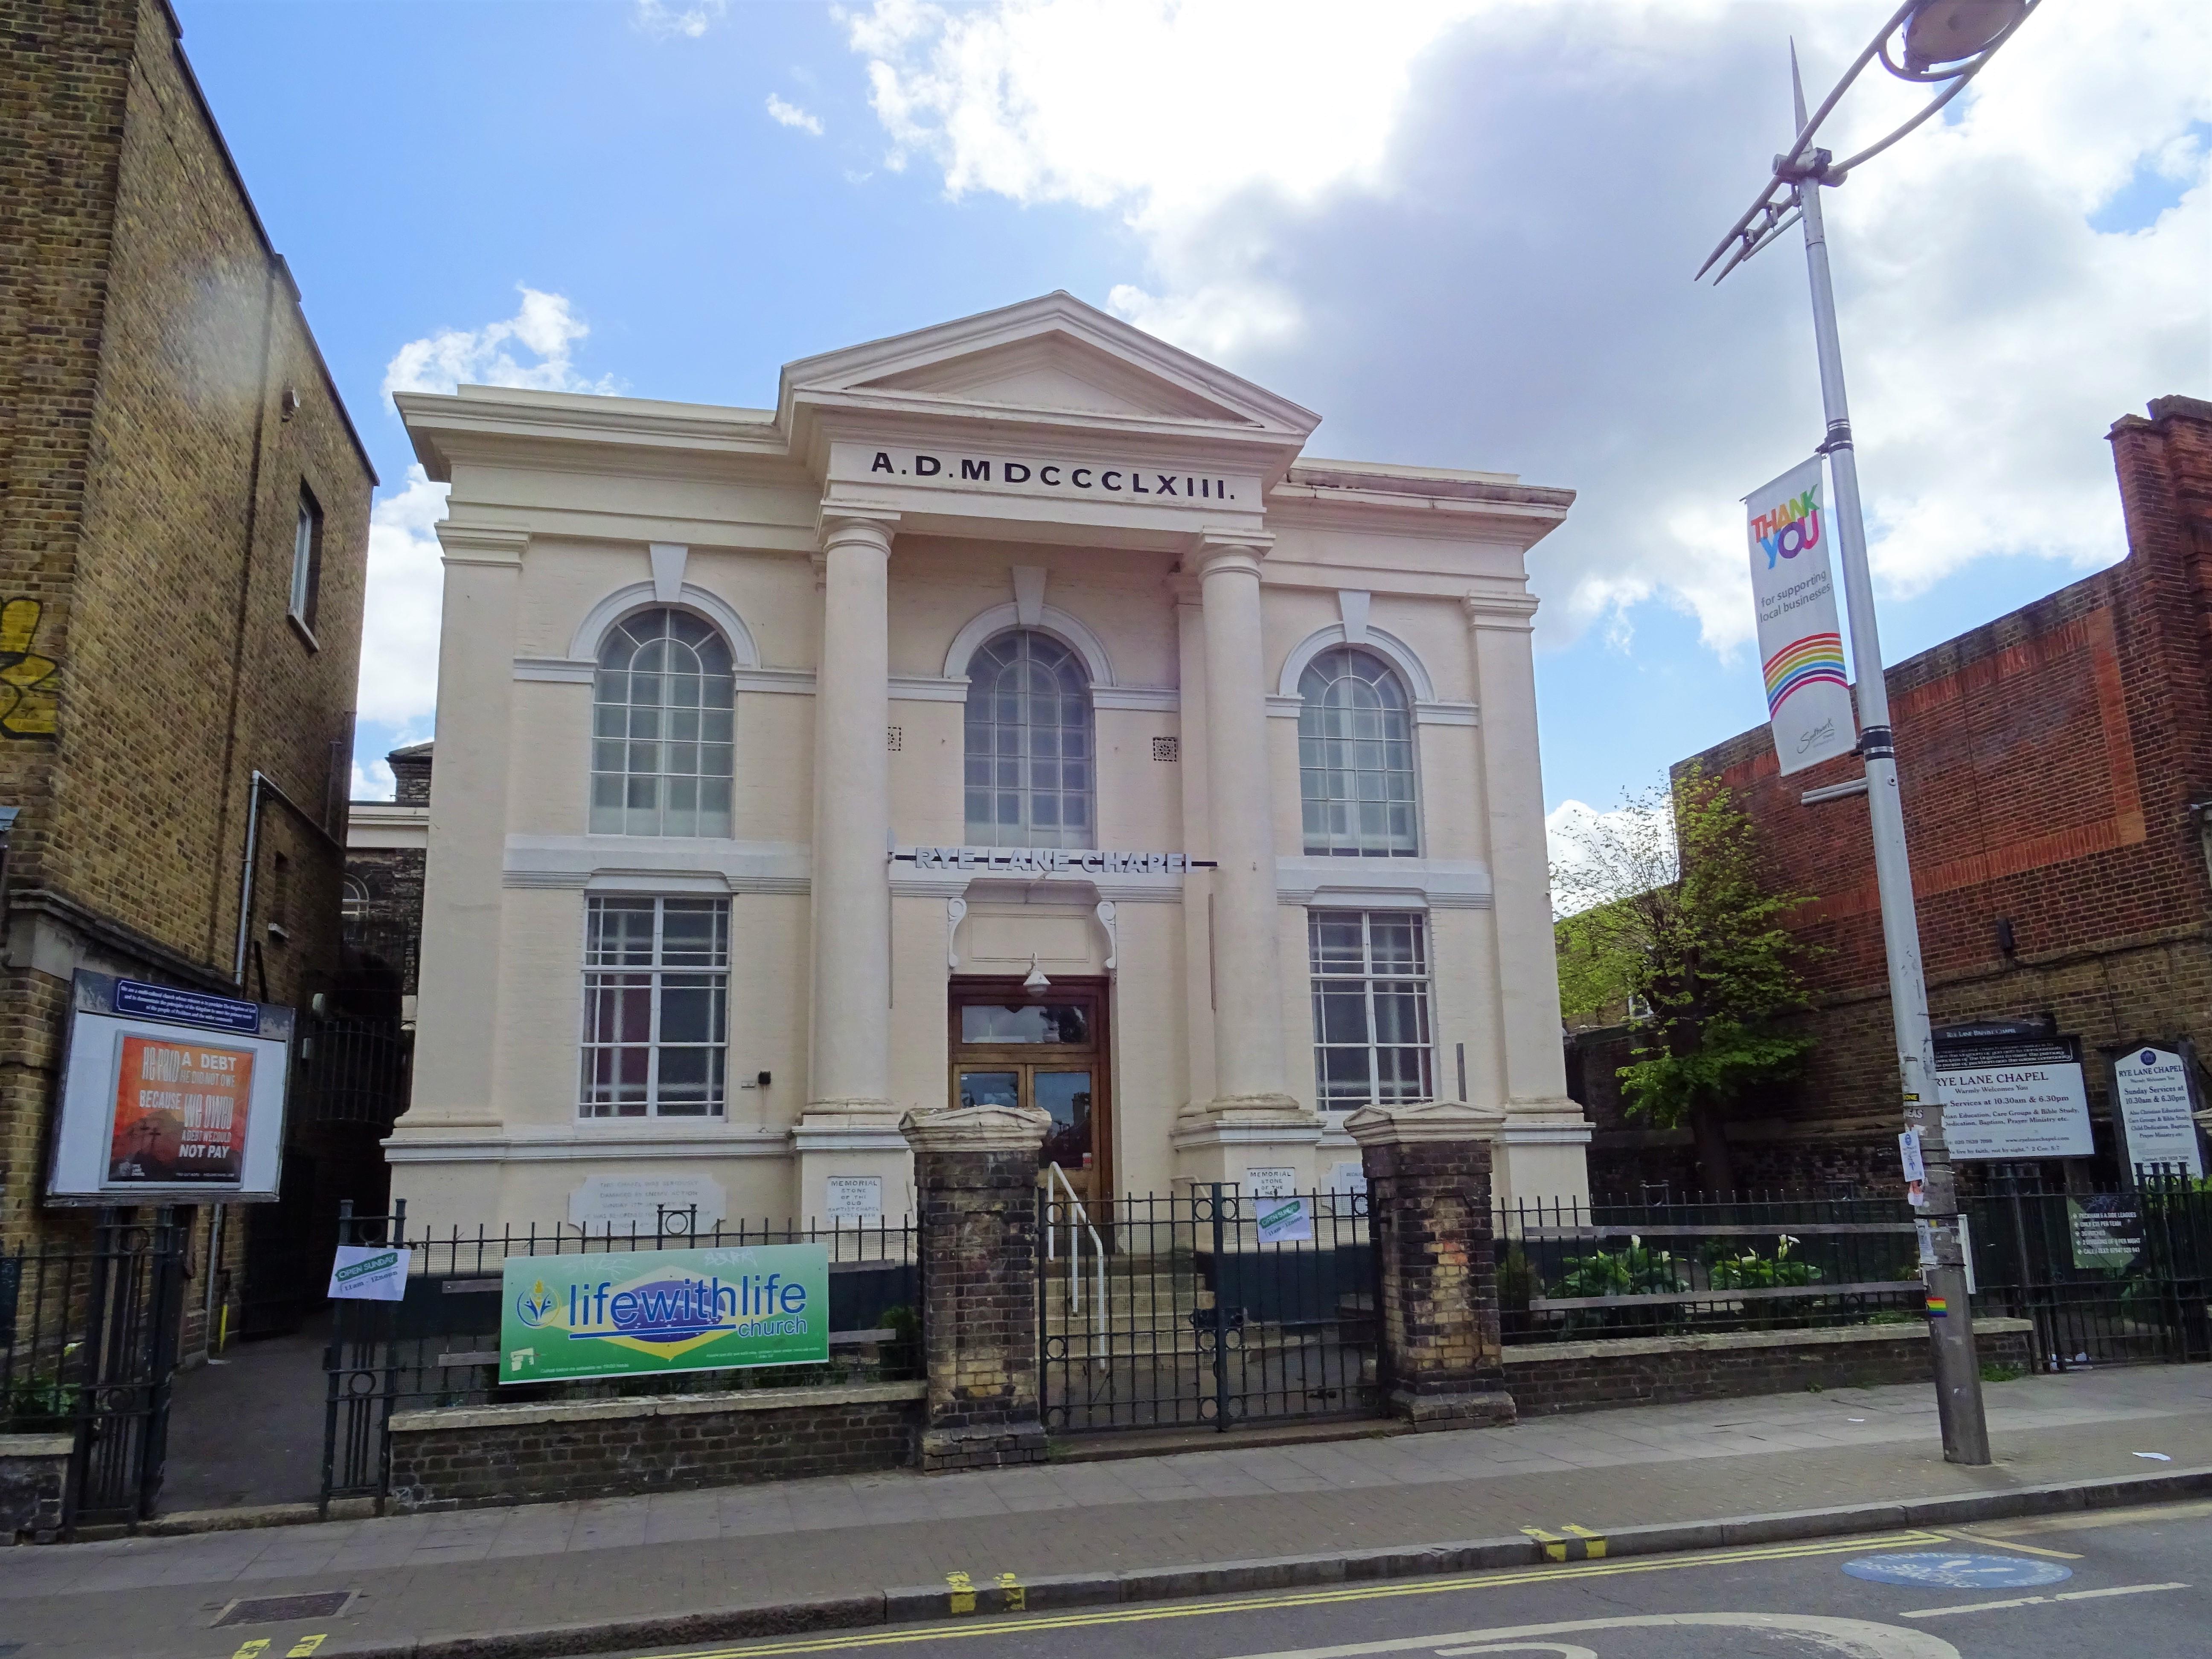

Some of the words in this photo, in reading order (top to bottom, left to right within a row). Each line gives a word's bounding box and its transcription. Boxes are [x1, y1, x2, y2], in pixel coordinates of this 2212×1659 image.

[1751, 483, 1820, 543] THANK
[1760, 510, 1819, 570] YOU
[1761, 592, 1776, 607] for
[1777, 570, 1827, 605] supporting
[1760, 605, 1781, 623] local
[1783, 583, 1831, 613] businesses
[915, 847, 975, 870] RYE
[987, 848, 1070, 873] LANE
[1082, 851, 1200, 874] CHAPEL
[182, 1051, 192, 1067] A
[201, 1053, 237, 1072] DEBT
[2133, 1068, 2153, 1076] LANE
[2154, 1065, 2183, 1074] CHAPEL
[221, 1074, 236, 1087] OWE
[1936, 1077, 1956, 1086] RYE
[1959, 1075, 1993, 1086] LANE
[1997, 1071, 2049, 1083] CHAPEL
[139, 1089, 182, 1110] BECAUSE
[2125, 1097, 2152, 1105] 10.30am
[2161, 1094, 2186, 1103] 6.30pm
[178, 1144, 206, 1158] NOT
[207, 1145, 230, 1159] PAY
[1261, 1214, 1278, 1225] OPEN
[1278, 1203, 1298, 1218] SUNDAY
[1285, 1216, 1303, 1227] 12noon
[338, 1265, 363, 1278] OPEN
[363, 1255, 395, 1270] SUNDAY
[344, 1281, 364, 1291] 11am
[371, 1271, 399, 1283] 12noon
[569, 1273, 807, 1327] lifewithlife
[737, 1314, 807, 1338] church
